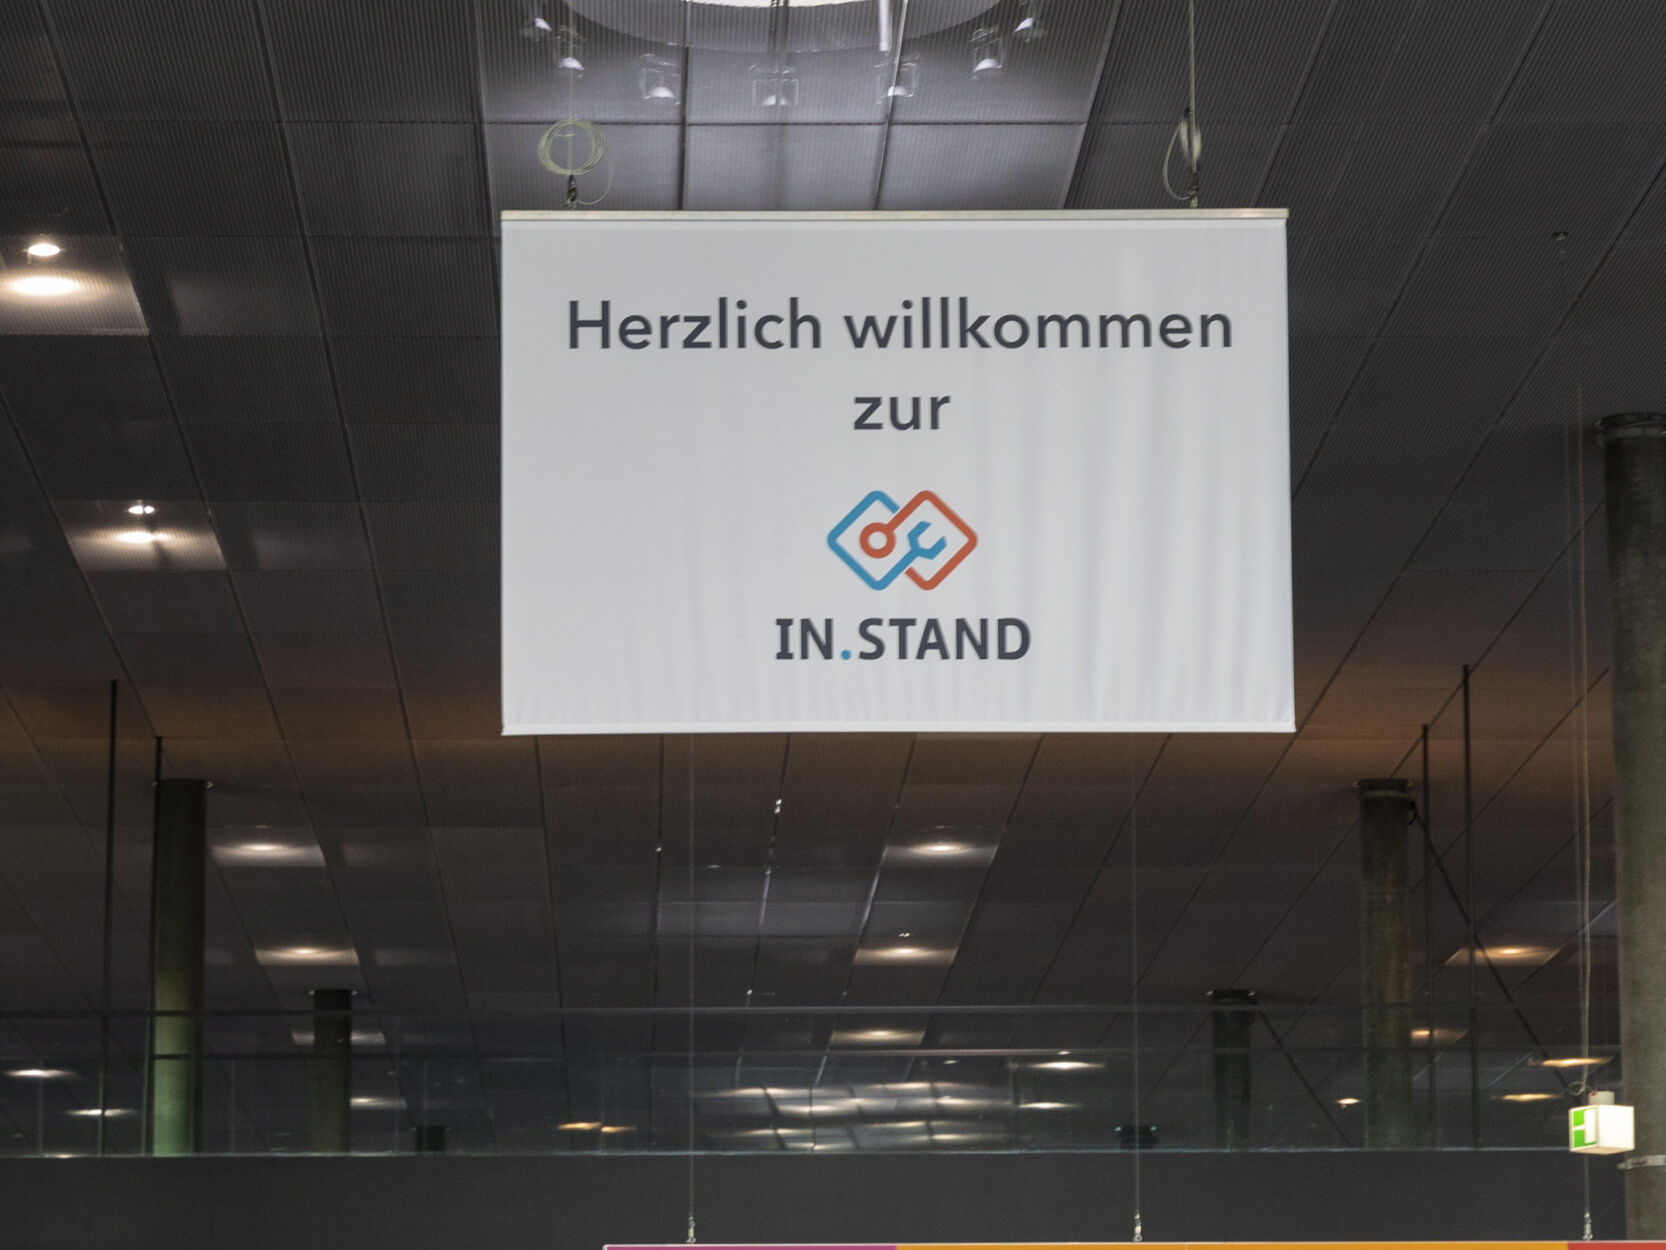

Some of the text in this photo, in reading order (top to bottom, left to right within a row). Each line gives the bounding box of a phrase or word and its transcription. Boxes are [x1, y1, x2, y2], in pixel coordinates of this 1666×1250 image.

[569, 296, 1232, 350] Herzlich willkommen
[853, 394, 951, 431] zur
[775, 617, 1031, 661] IN.STAND
